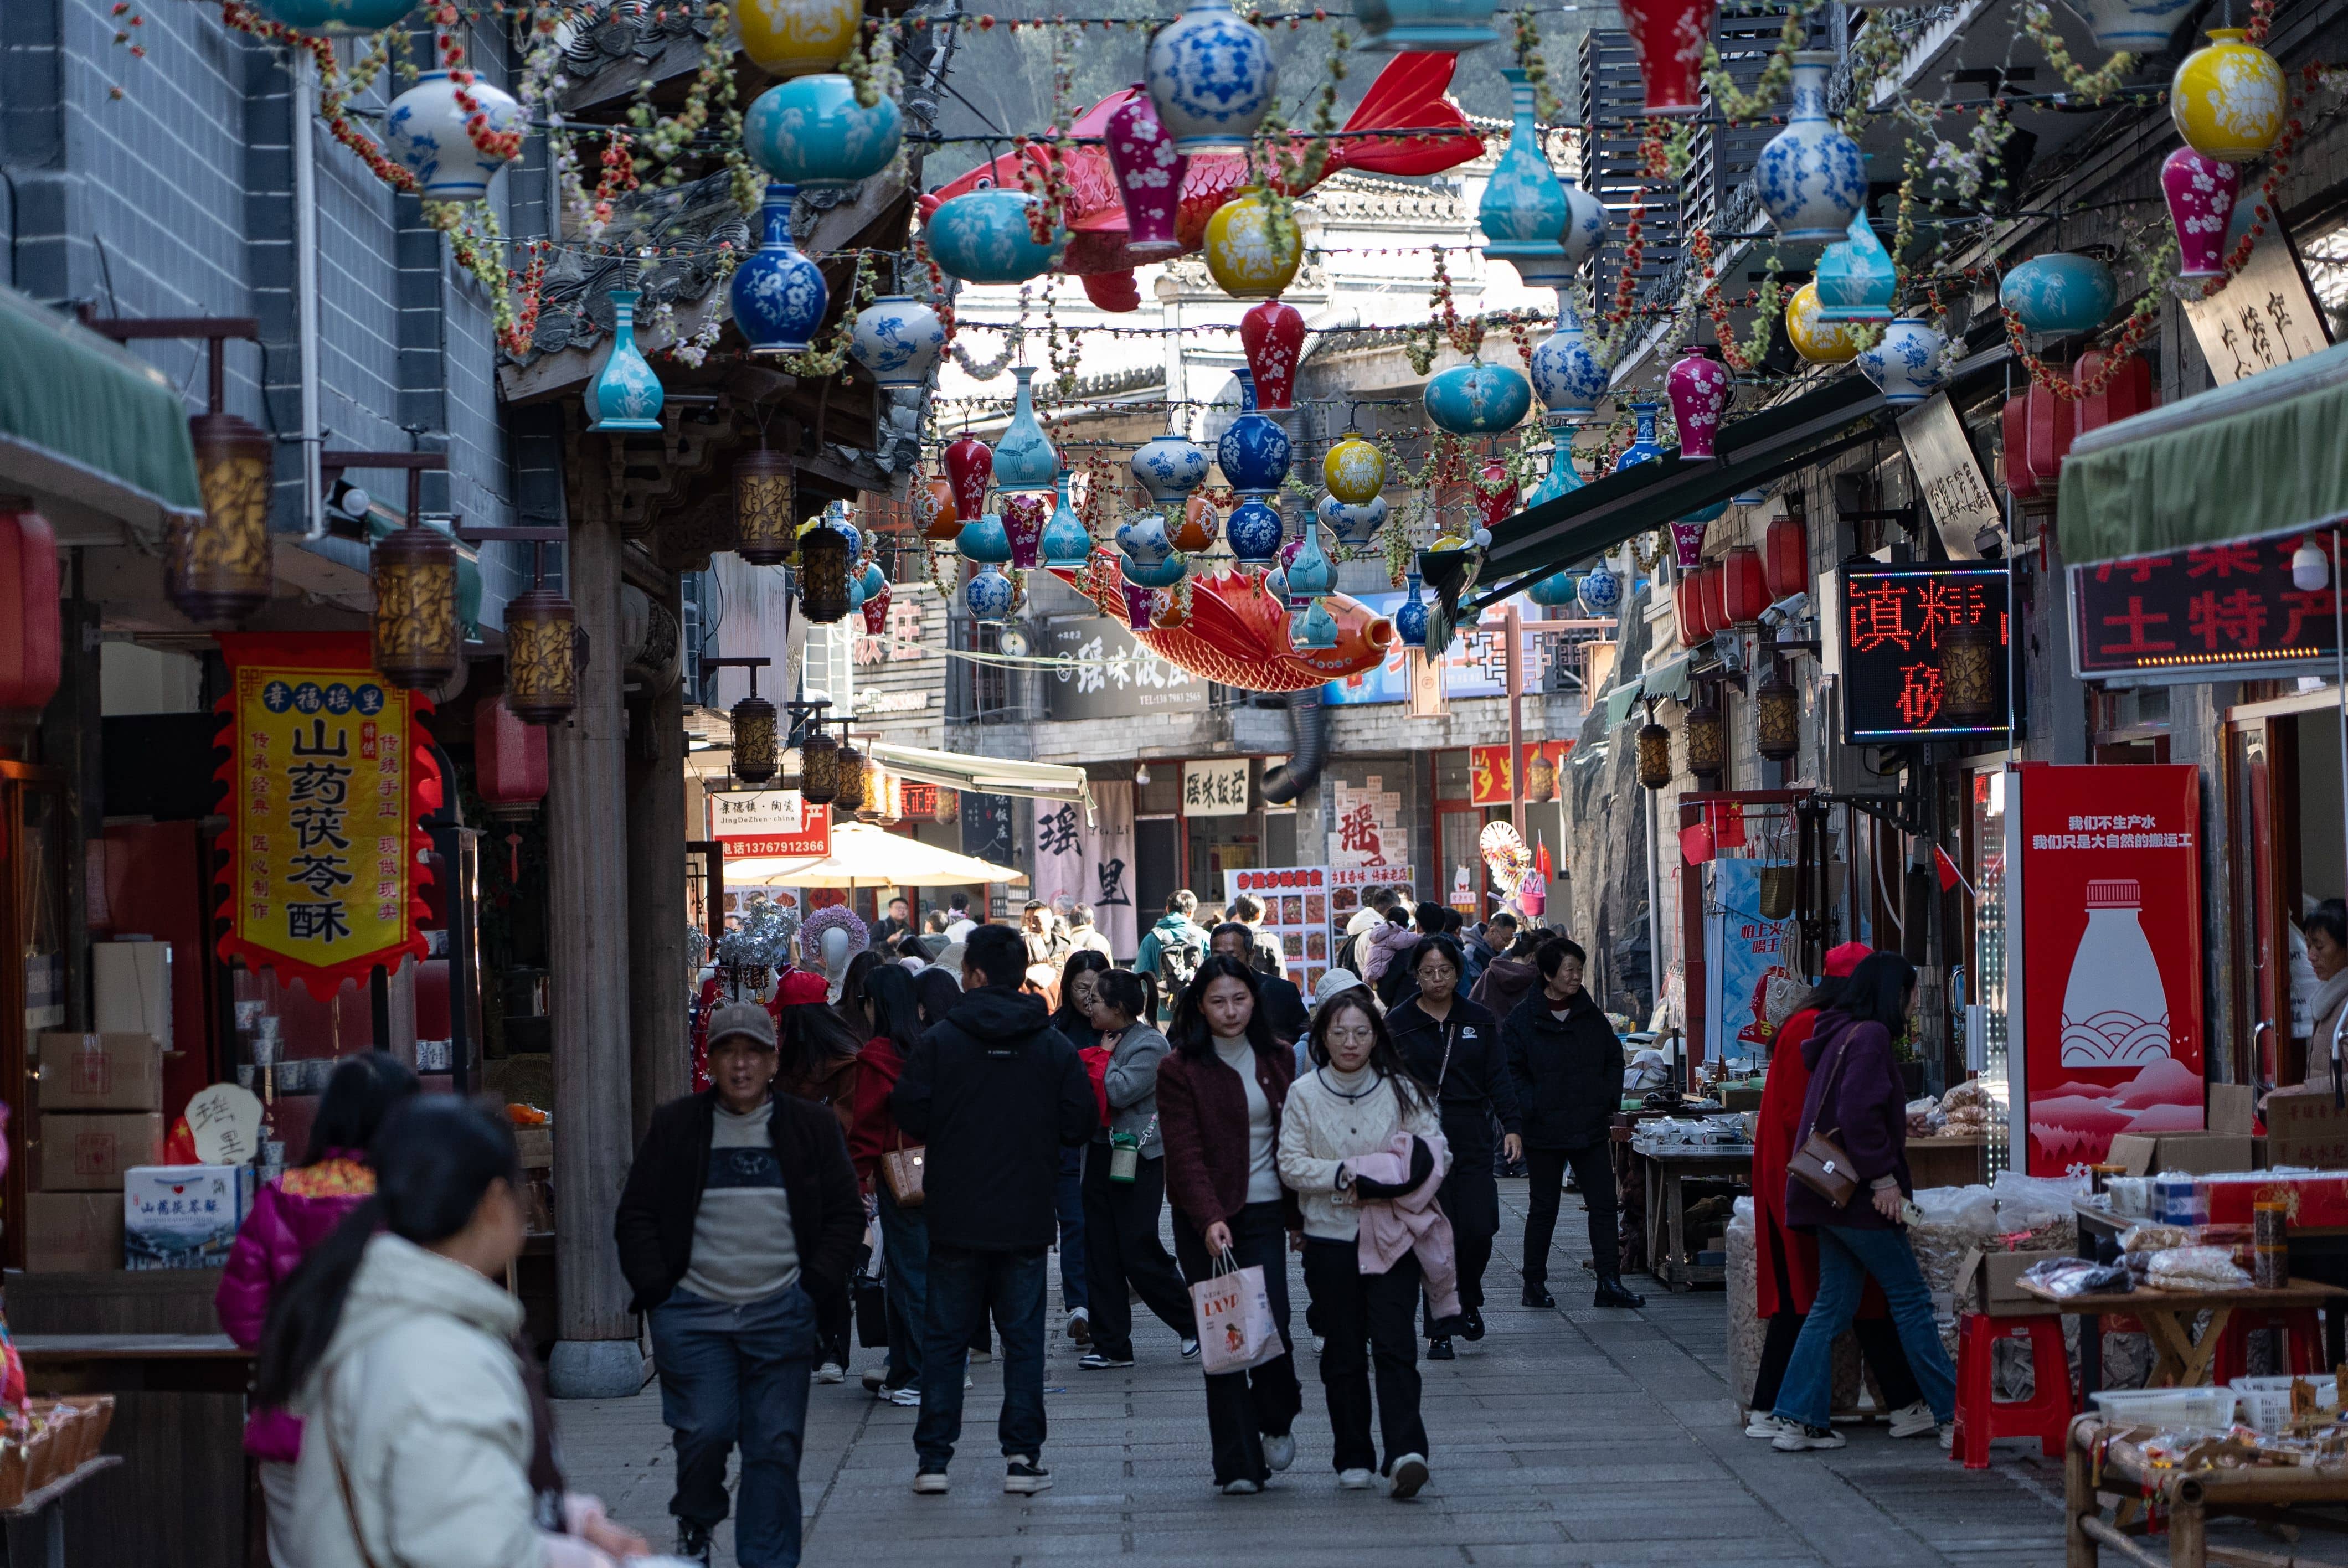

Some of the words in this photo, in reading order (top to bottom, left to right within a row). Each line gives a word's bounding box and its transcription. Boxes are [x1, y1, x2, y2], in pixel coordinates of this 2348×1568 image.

[1850, 579, 2009, 652] 镇精
[2101, 588, 2348, 654] 土特产
[264, 682, 382, 711] 幸福瑶里
[251, 732, 270, 816] 传承经典
[379, 735, 399, 816] 传统手工
[719, 799, 794, 814] 景德镇·陶瓷
[805, 804, 824, 832] 产
[286, 719, 352, 942] 山药茯苓酥
[2068, 815, 2156, 831] 我们不生产水
[723, 840, 824, 855] 电话13767912366
[2033, 833, 2192, 850] 我们只是大自然的搬运工
[251, 835, 269, 919] 匠心制作
[378, 837, 398, 920] 现做现卖
[1237, 869, 1323, 890] 乡里乡味美食
[1332, 869, 1366, 885] 乡里香味
[1372, 866, 1407, 882] 传承老店
[1741, 921, 1783, 939] 怕上火
[195, 1095, 245, 1156] 瑶里
